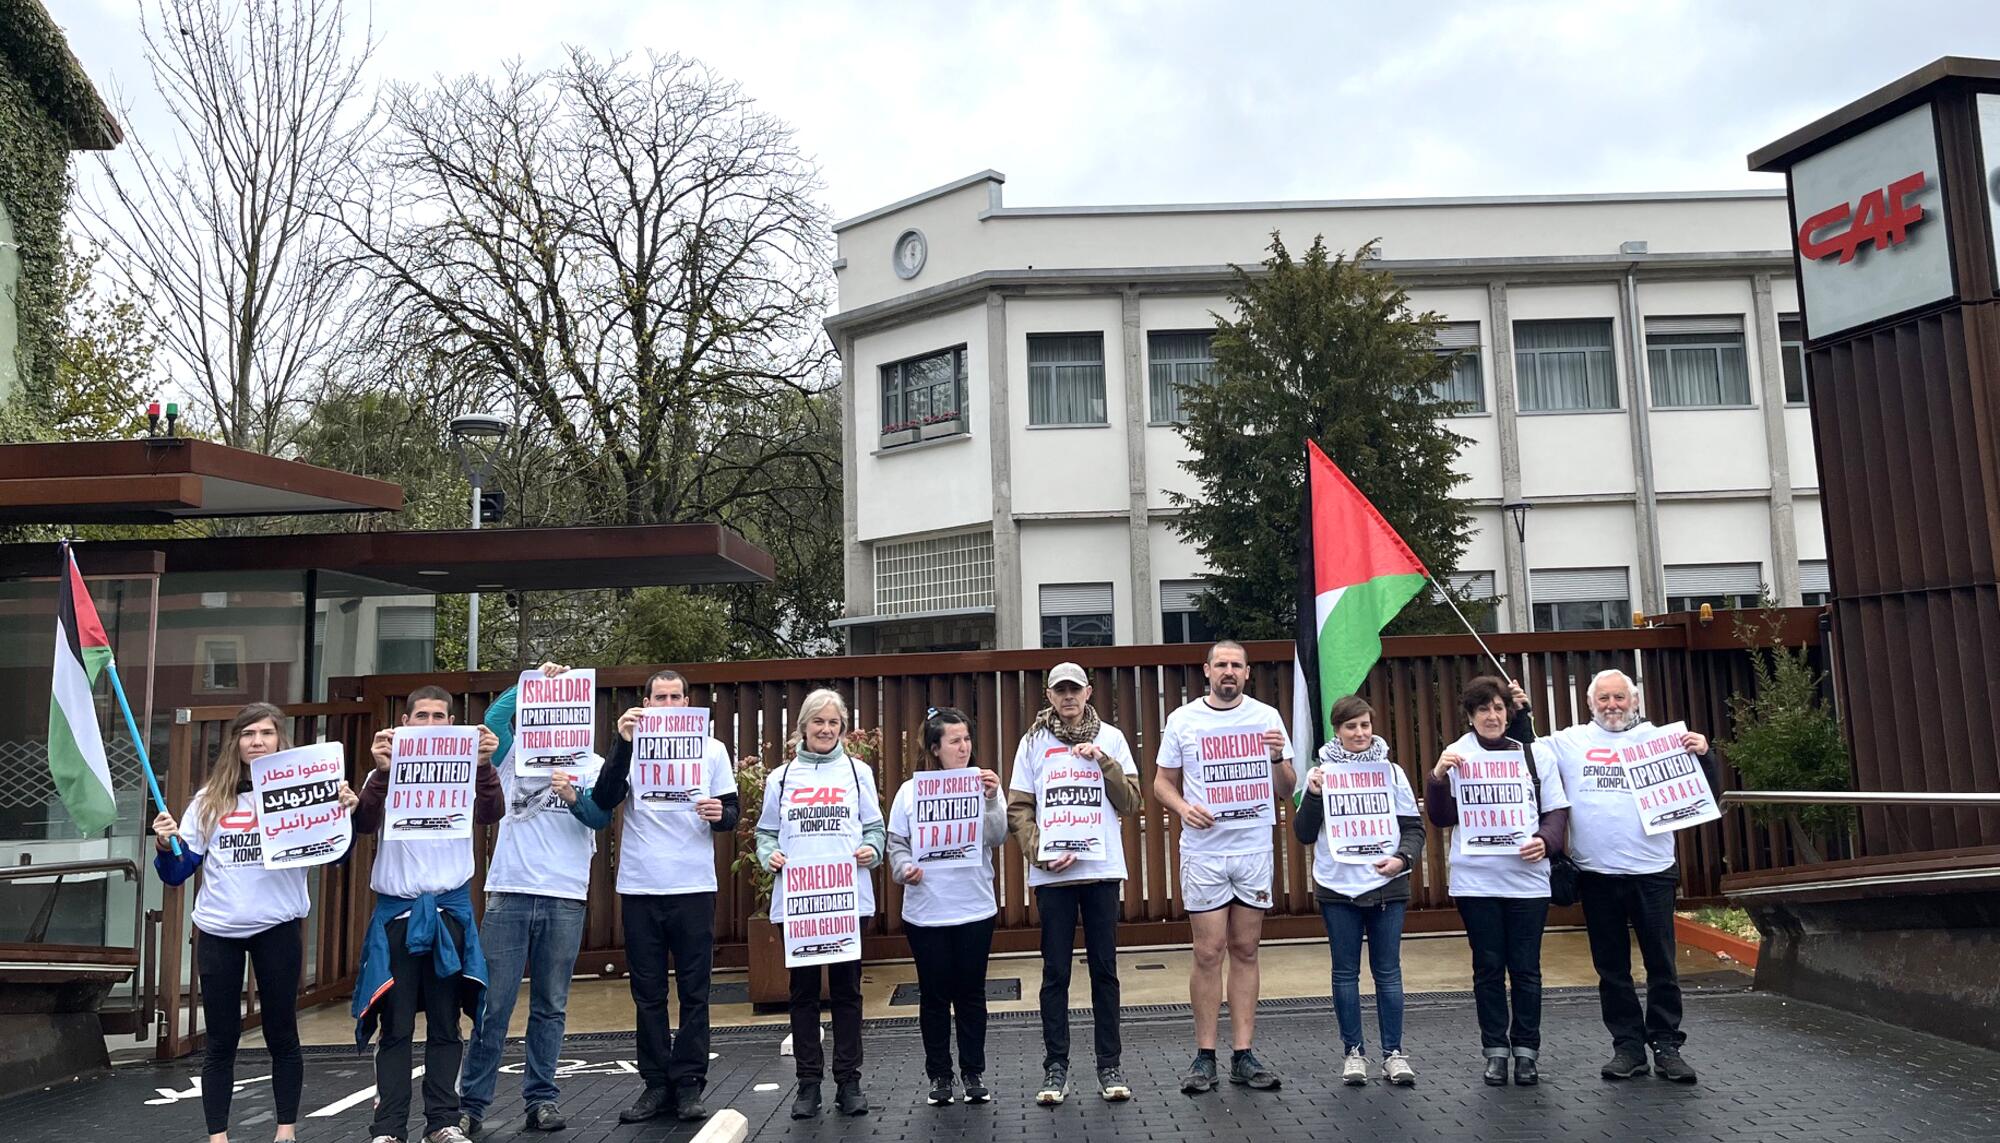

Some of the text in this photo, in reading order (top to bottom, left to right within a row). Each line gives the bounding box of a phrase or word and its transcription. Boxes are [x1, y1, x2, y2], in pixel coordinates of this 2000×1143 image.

[1798, 171, 1926, 265] CAF
[522, 678, 591, 703] ISRAELDAR
[523, 708, 590, 726] APARTHEIDAREN
[639, 715, 704, 733] STOP ISRAEL'S
[399, 737, 473, 757] NO AL TREN DE
[522, 729, 590, 749] TRENA GELDITU
[639, 737, 701, 759] APARTHEID
[1201, 733, 1265, 760] ISRAELDAR
[1622, 747, 1636, 763] NO
[1636, 744, 1649, 760] AL
[1646, 736, 1670, 758] TREN
[260, 757, 341, 786] أوقفوا قطار
[396, 762, 469, 783] L'APARTHEID
[640, 763, 701, 785] TRAIN
[1046, 766, 1067, 783] قطار
[1204, 762, 1267, 781] APARTHEIDAREN
[1326, 772, 1386, 789] NO AL TREN DEL
[1460, 761, 1520, 779] NO AL TREN DE
[1631, 753, 1693, 788] APARTHEID
[791, 787, 847, 806] CAF
[917, 776, 981, 796] STOP ISRAEL'S
[1046, 787, 1100, 805] الأبارتهايد
[1206, 782, 1270, 804] TRENA GELDITU
[1462, 784, 1522, 804] L'APARTHEID
[1640, 778, 1705, 810] DE ISRAEL
[787, 806, 850, 821] GENOZIDIOAREN
[919, 797, 978, 821] APARTHEID
[1330, 793, 1388, 815] APARTHEID
[265, 806, 347, 840] الإسرائيلي
[800, 818, 841, 832] KONPLIZE
[1332, 819, 1393, 838] DE ISRAEL
[219, 833, 261, 849] GENOZID
[918, 821, 977, 848] TRAIN
[233, 848, 263, 863] KONP
[787, 862, 853, 893] ISRAELDAR
[788, 893, 854, 915] APARTHEIDAREN
[788, 915, 856, 938] TRENA GELDITU
